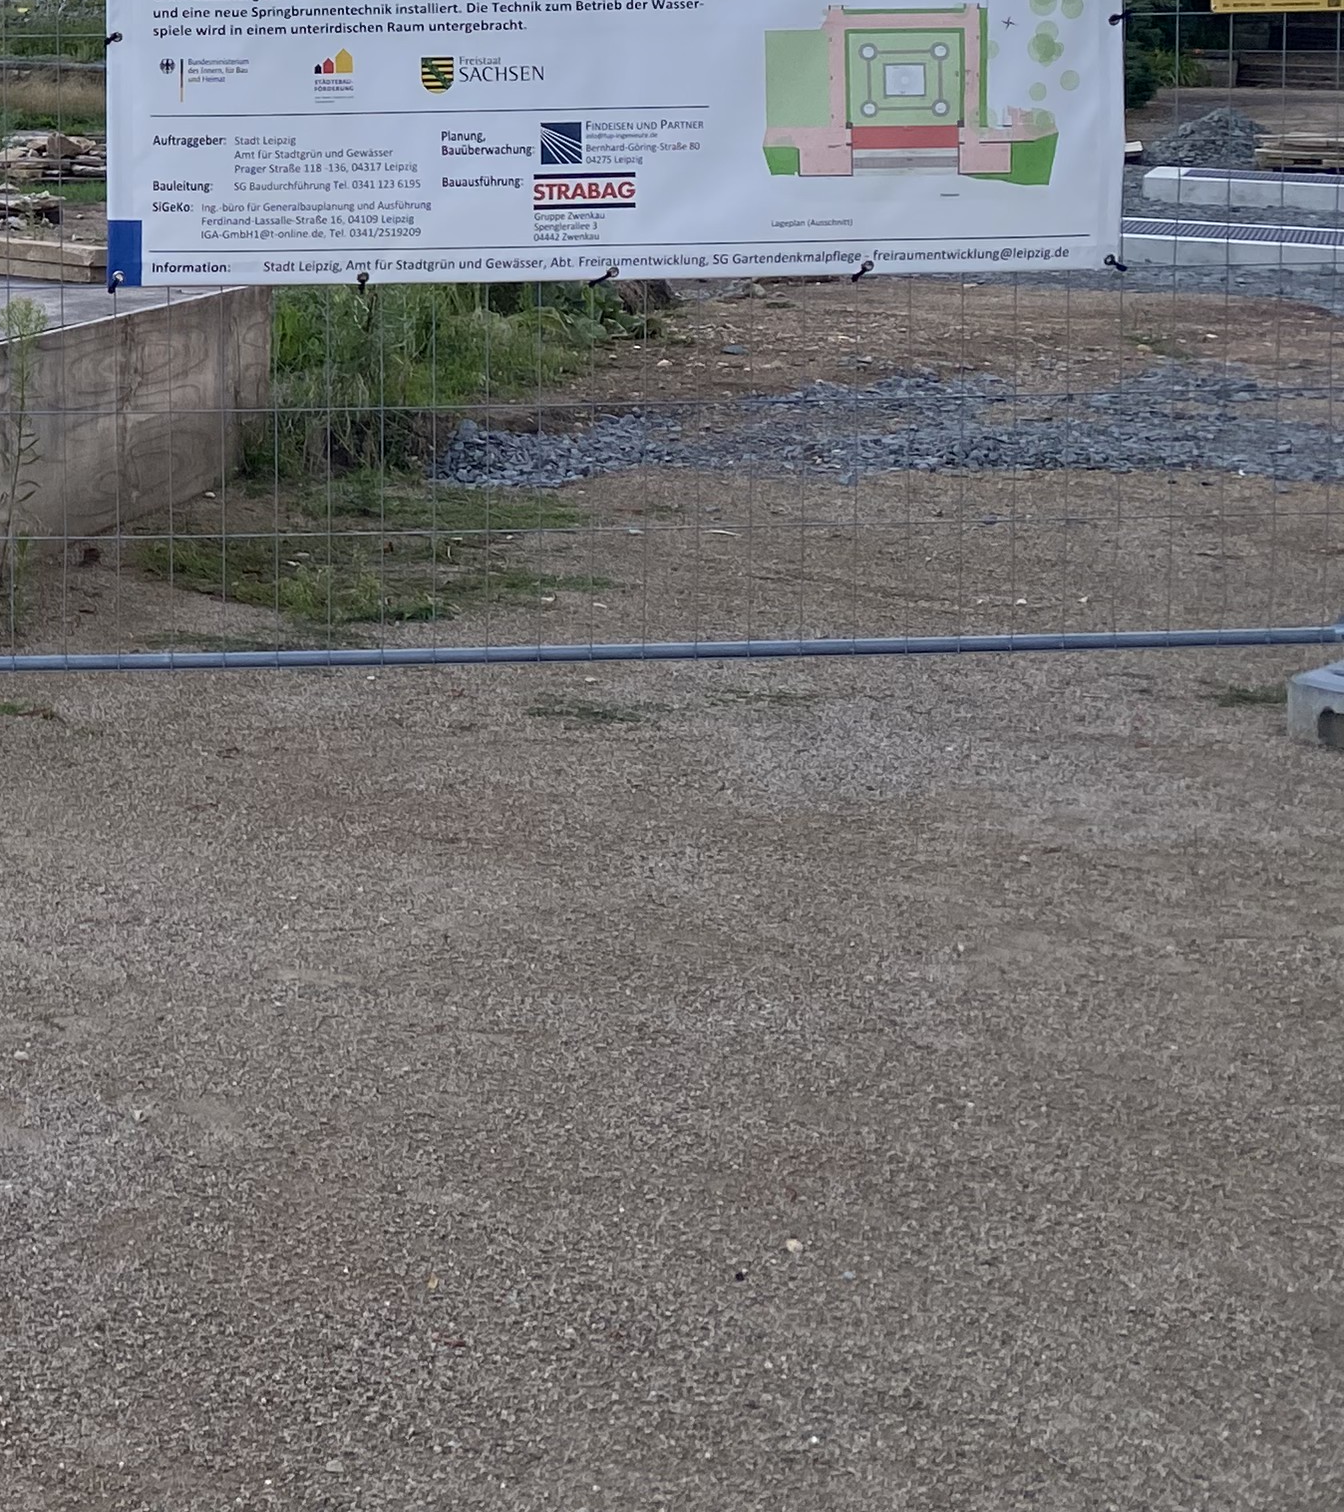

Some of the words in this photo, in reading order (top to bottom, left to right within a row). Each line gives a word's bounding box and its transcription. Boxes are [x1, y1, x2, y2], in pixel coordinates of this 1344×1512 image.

[152, 7, 178, 18] und
[181, 6, 210, 18] eine
[214, 8, 248, 18] neue
[250, 3, 392, 20] Springbrunnentechnik
[395, 2, 462, 14] installiert.
[466, 2, 488, 13] Die
[491, 0, 542, 13] Technik
[544, 2, 572, 12] zum
[575, 0, 622, 11] Betrieb
[625, 0, 648, 10] der
[152, 24, 192, 39] spiele
[195, 24, 226, 36] wird
[246, 23, 287, 35] einem
[290, 21, 383, 34] unterirdischen
[386, 21, 424, 32] Raum
[428, 19, 527, 34] untergebracht.
[458, 55, 501, 66] Freistaat
[458, 65, 544, 82] SACHSEN
[152, 134, 227, 148] Auftraggeber:
[233, 135, 260, 145] Stadt
[262, 135, 296, 146] Leipzig
[440, 130, 486, 144] Planung,
[233, 149, 255, 159] Amt
[257, 149, 273, 159] für
[274, 149, 323, 161] Stadtgrün
[324, 148, 344, 158] und
[345, 147, 394, 158] Gewässer
[440, 144, 535, 157] Bauüberwachung:
[585, 141, 688, 154] Bernhard-Göring-Straße
[585, 155, 612, 164] 04275
[613, 155, 643, 165] Leipzig
[233, 164, 267, 175] Prager
[268, 163, 301, 173] Straße
[303, 162, 322, 173] 118
[350, 162, 382, 172] 04317
[383, 161, 418, 173] Leipzig
[152, 180, 213, 194] Bauleitung:
[248, 180, 331, 193] Baudurchführung
[351, 179, 375, 189] 0341
[377, 178, 395, 189] 123
[396, 178, 421, 188] 6195
[441, 175, 523, 189] Bauausführung:
[532, 181, 636, 201] STRABAG
[151, 201, 193, 212] SiGeKo:
[262, 201, 355, 213] Generalbauplanung
[356, 200, 375, 210] und
[376, 199, 432, 211] Ausführung
[200, 214, 328, 226] Ferdinand-Lassalle-Straße
[330, 214, 346, 225] 16,
[347, 214, 379, 224] 04109
[380, 214, 415, 225] Leipzig
[533, 211, 566, 222] Gruppe
[566, 211, 606, 220] Zwenkau
[770, 219, 806, 228] Lageplan
[806, 218, 853, 227] (Ausschnitt)
[348, 226, 422, 238] 0341/2519209
[533, 221, 591, 232] Spenglerallee
[533, 232, 560, 242] 04442
[561, 231, 600, 241] Zwenkau
[263, 260, 295, 272] Stadt
[298, 260, 343, 273] Leipzig,
[344, 259, 371, 271] Amt
[374, 258, 393, 270] für
[394, 258, 455, 272] Stadtgrün
[458, 257, 482, 269] und
[484, 256, 547, 270] Gewässer,
[549, 256, 574, 268] Abt.
[578, 253, 709, 269] Freiraumentwicklung,
[711, 253, 729, 265] SG
[731, 250, 862, 266] Gartendenkmalpflege
[872, 246, 1069, 264] freiraumentwicklung@leipzig.de
[151, 261, 231, 273] Information:
